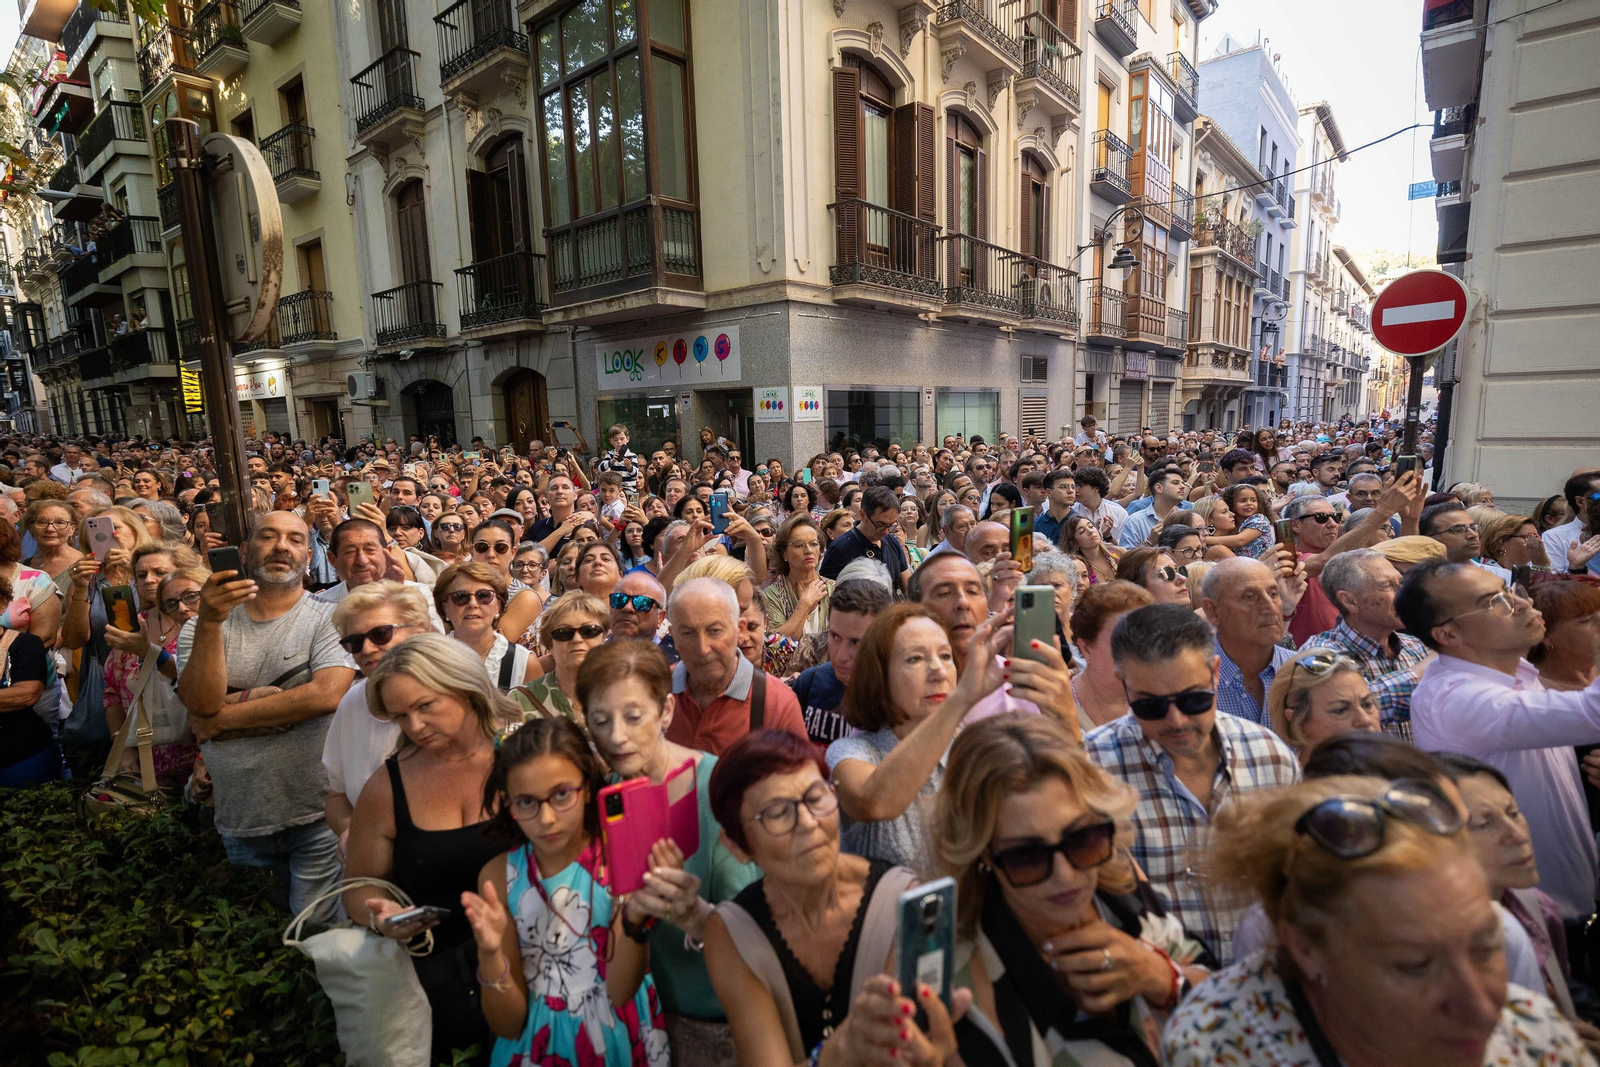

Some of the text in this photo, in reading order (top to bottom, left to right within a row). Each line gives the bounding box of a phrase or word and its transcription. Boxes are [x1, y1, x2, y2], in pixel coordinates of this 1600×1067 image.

[508, 347, 514, 356] 17
[603, 338, 727, 381] LOOK KIDS
[179, 360, 203, 414] ZZERIA
[763, 389, 779, 399] LOOK
